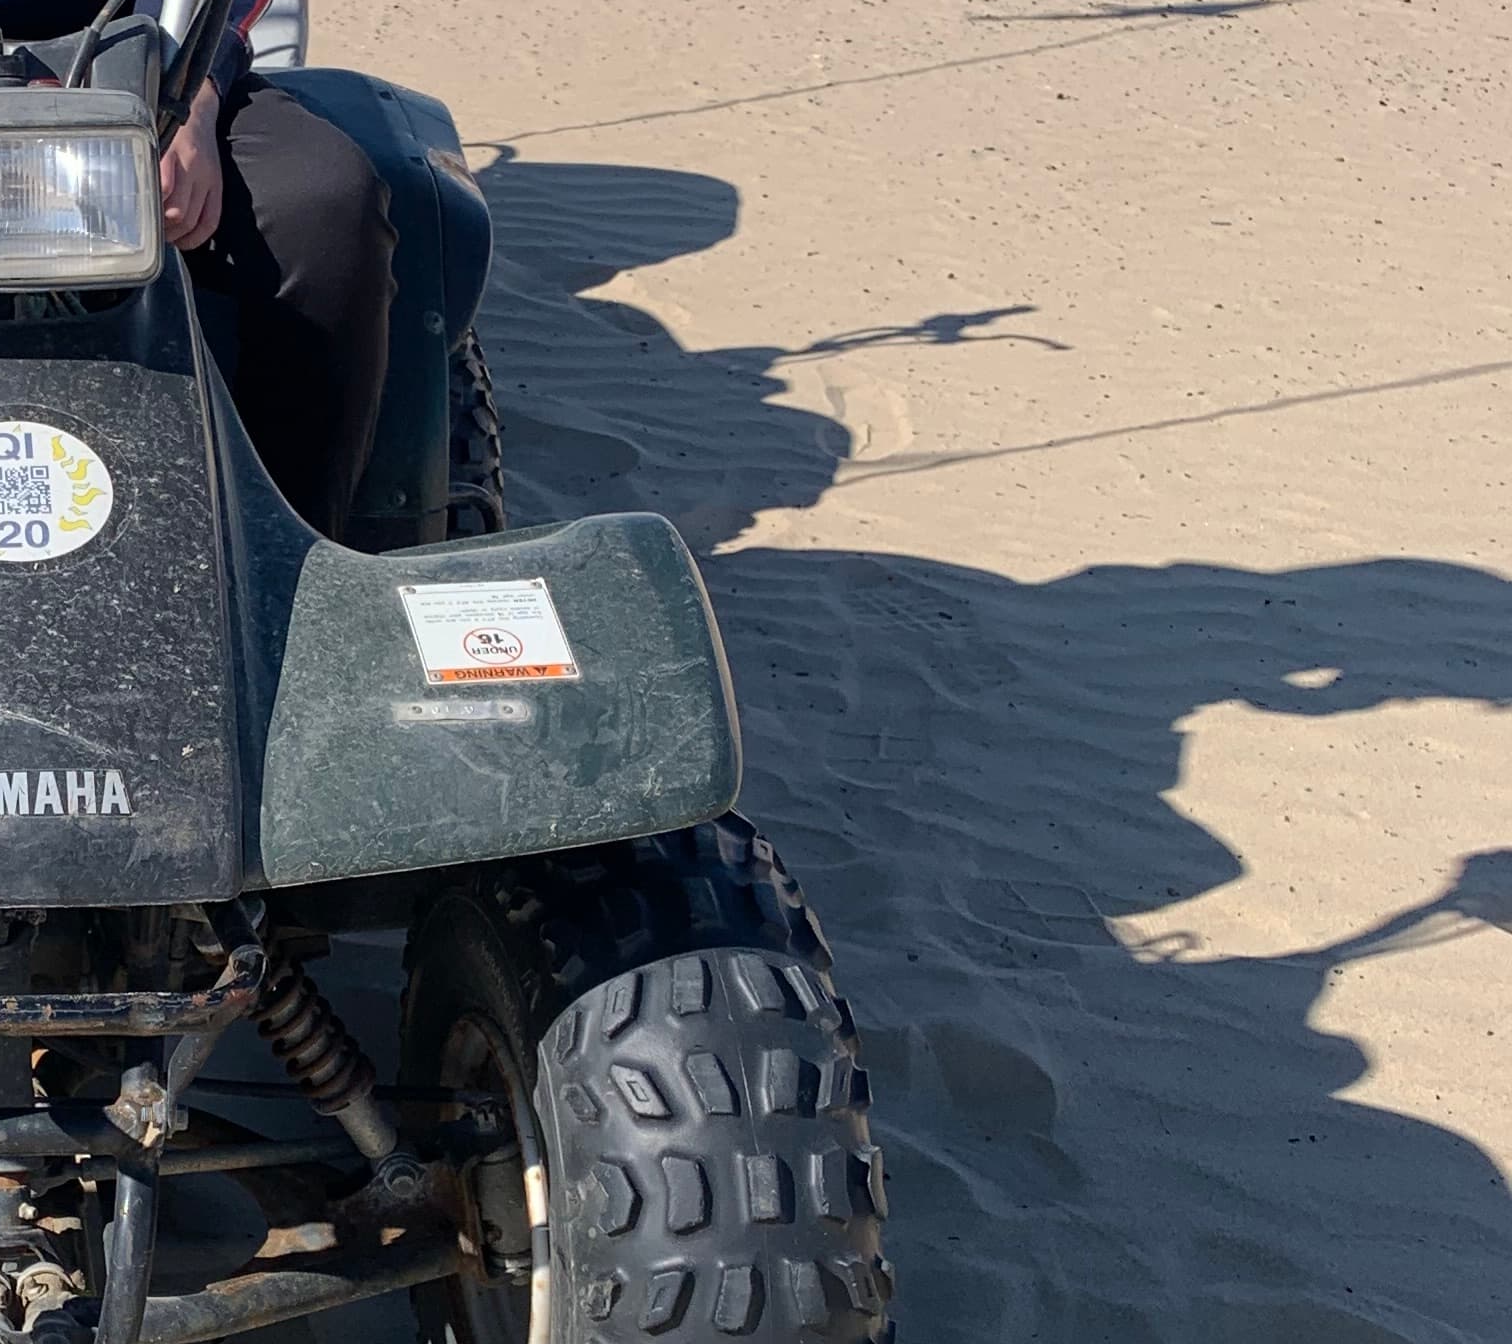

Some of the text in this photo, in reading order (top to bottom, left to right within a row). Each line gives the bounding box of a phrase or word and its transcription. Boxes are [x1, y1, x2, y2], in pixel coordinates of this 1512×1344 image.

[477, 633, 504, 645] 16
[471, 645, 518, 655] UNDER
[455, 666, 532, 680] WARNING
